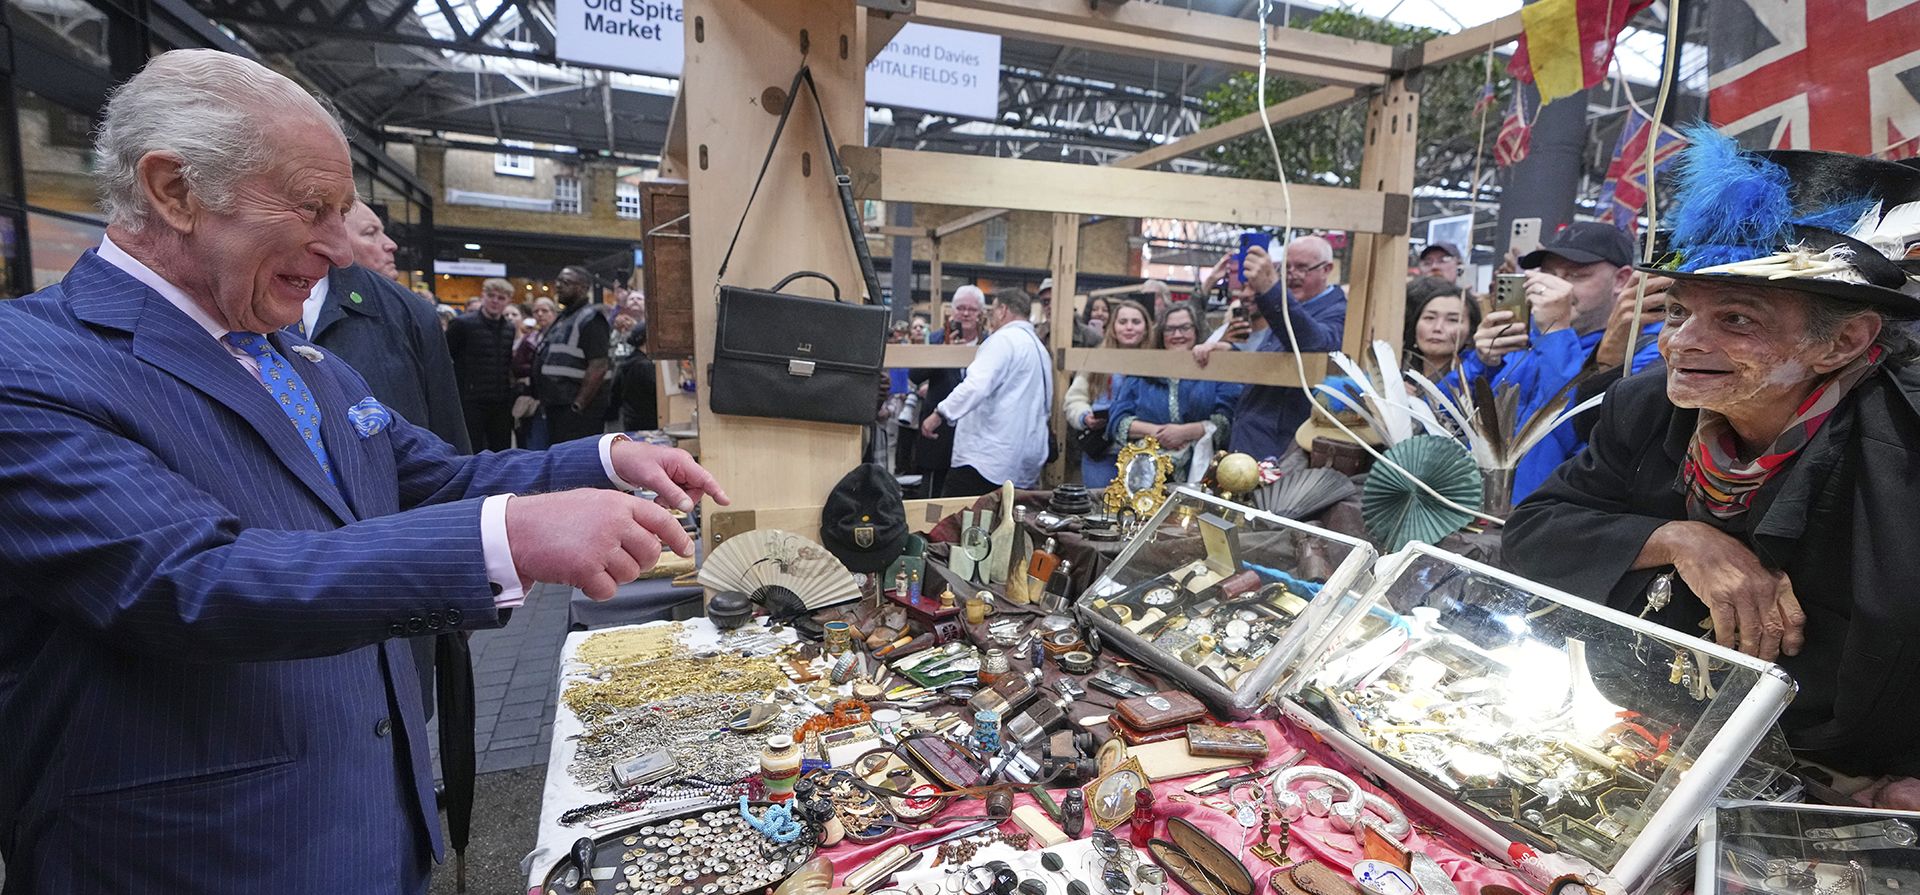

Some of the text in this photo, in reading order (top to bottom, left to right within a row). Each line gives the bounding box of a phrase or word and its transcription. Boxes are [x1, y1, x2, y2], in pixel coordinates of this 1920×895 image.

[585, 12, 661, 41] Market
[903, 44, 930, 58] and
[934, 46, 980, 66] Davies
[962, 73, 977, 88] 91
